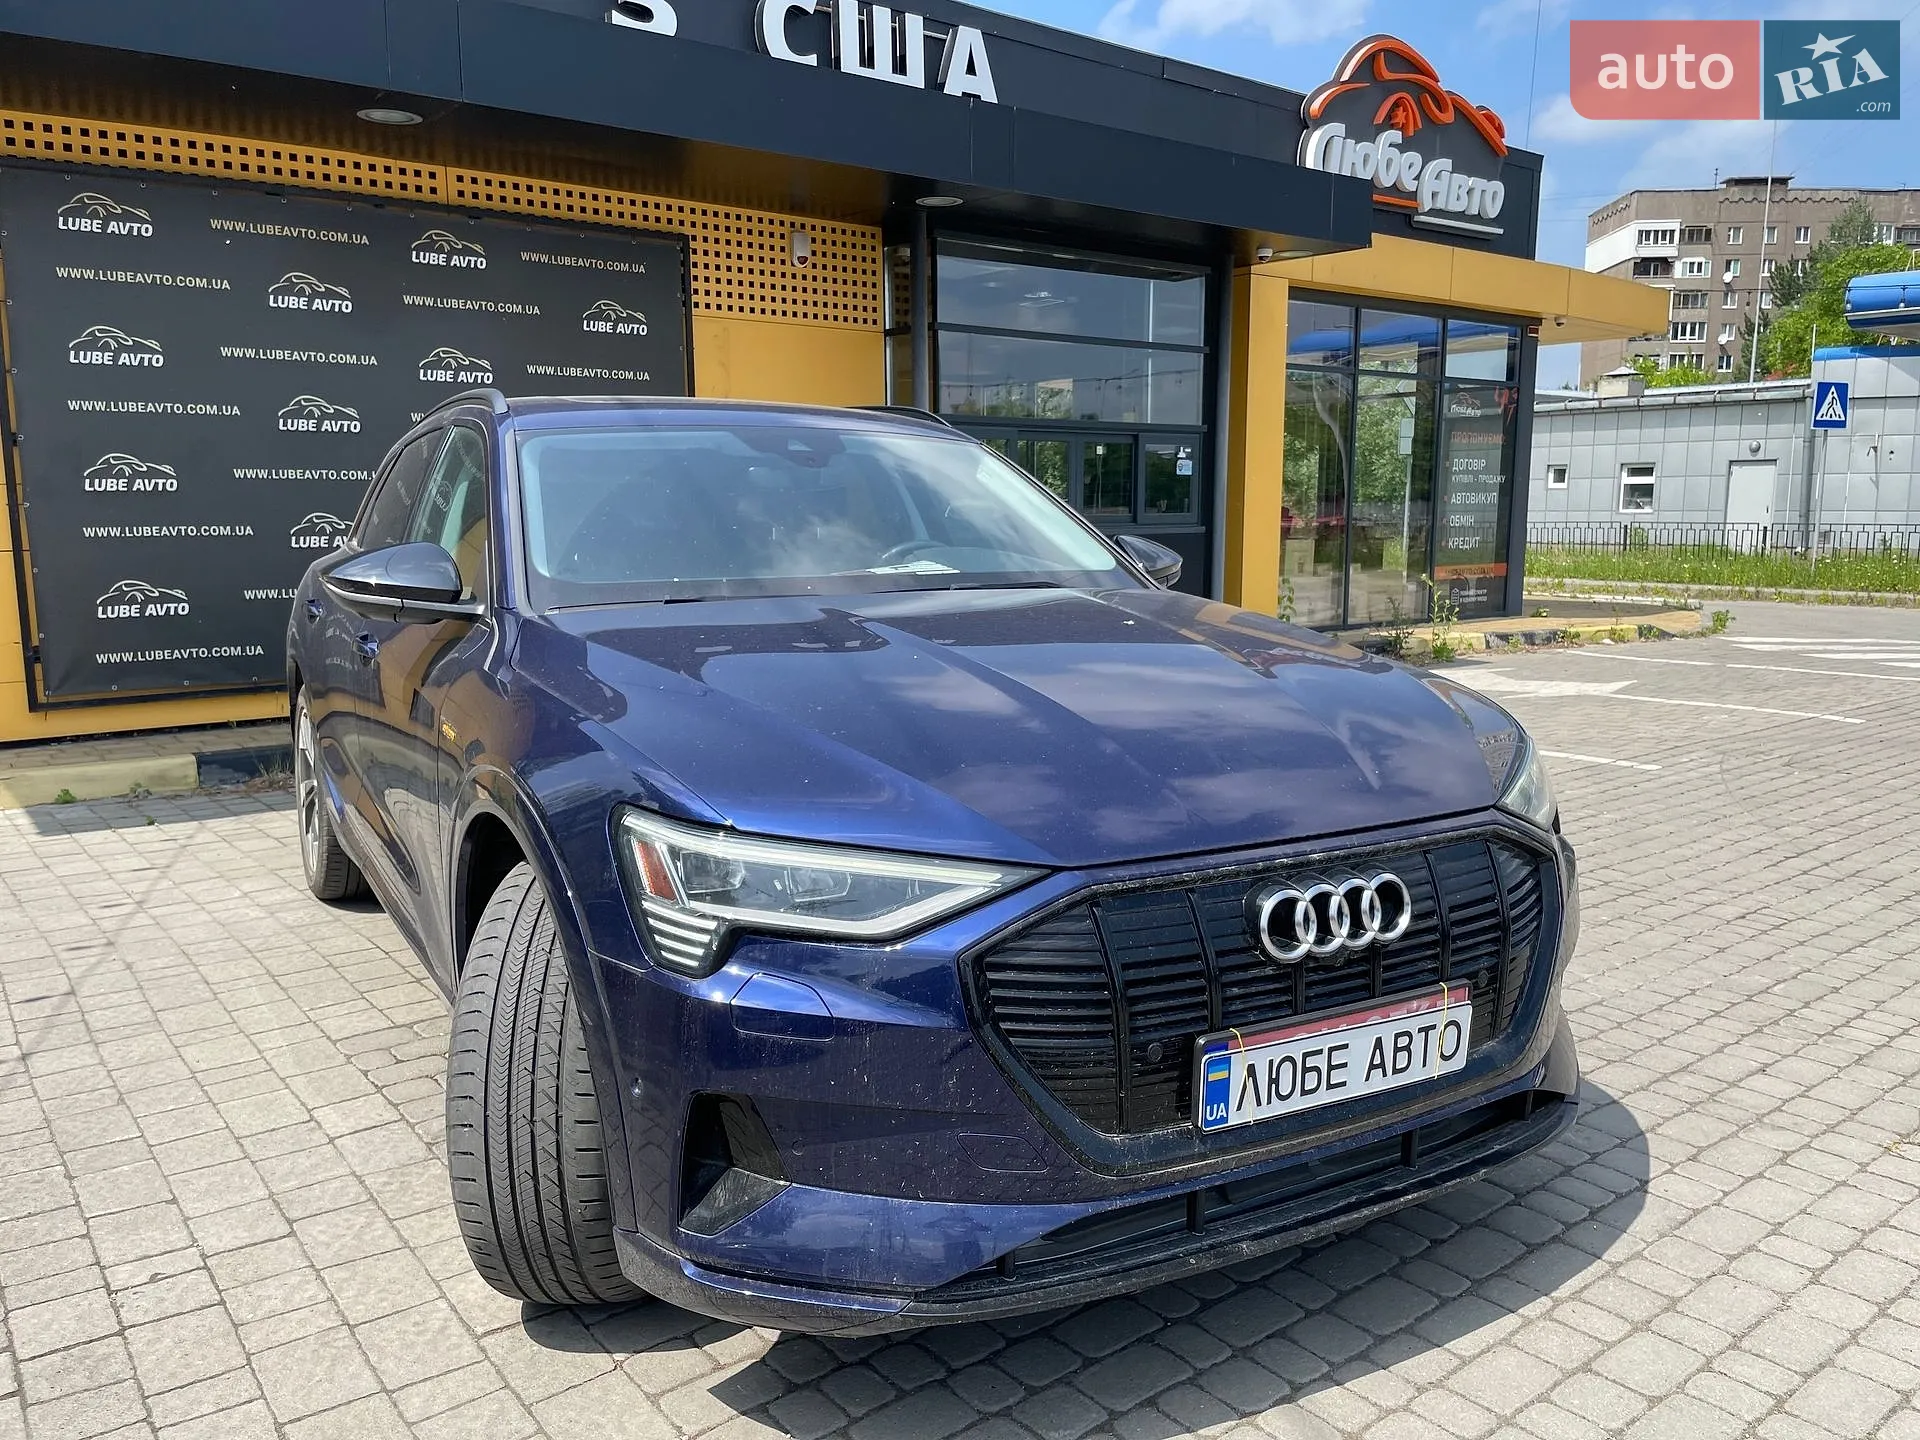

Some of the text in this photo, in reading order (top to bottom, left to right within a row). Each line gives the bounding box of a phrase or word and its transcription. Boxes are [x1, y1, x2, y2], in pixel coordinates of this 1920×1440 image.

[757, 0, 999, 104] США
[1305, 122, 1505, 219] Любе Авто
[59, 216, 152, 236] LUBE AVTO
[211, 219, 369, 244] WWW.LUBEAVTO.COM.UA
[412, 251, 486, 268] LUBE AVTO
[521, 252, 646, 273] WWW.LUBEAVTO.COM.UA
[56, 267, 230, 290] WWW.LUBEAVTO.COM.UA
[269, 294, 352, 312] LUBE AVTO
[403, 295, 540, 314] WWW.LUBEAVTO.COM.UA
[584, 320, 647, 335] LUBE AVTO
[70, 350, 163, 366] LUBE AVTO
[221, 347, 377, 365] WWW.LUBEAVTO.COM.UA
[420, 370, 493, 384] LUBE AVTO
[527, 365, 649, 380] WWW.LUBEAVTO.COM.UA
[68, 400, 240, 415] WWW.LUBEAVTO.COM.UA
[279, 418, 360, 432] LUBE AVTO
[1452, 459, 1486, 472] ДОГОВІР
[234, 469, 374, 481] WWW.LUBEAVTO.COM.
[85, 479, 177, 491] LUBE AVTO
[1450, 493, 1497, 504] АВТОВИКУП
[1449, 515, 1474, 527] ОБМІН
[83, 526, 253, 537] WWW.LUBEAVTO.COM.UA
[292, 536, 329, 547] LUBE
[1448, 537, 1480, 550] КРЕДИТ
[97, 603, 189, 618] LUBE AVTO
[96, 646, 264, 663] WWW.LUBEAVTO.COM.UA
[1236, 1019, 1462, 1112] ЛЮБЕ АВТО
[1206, 1103, 1227, 1121] UA
